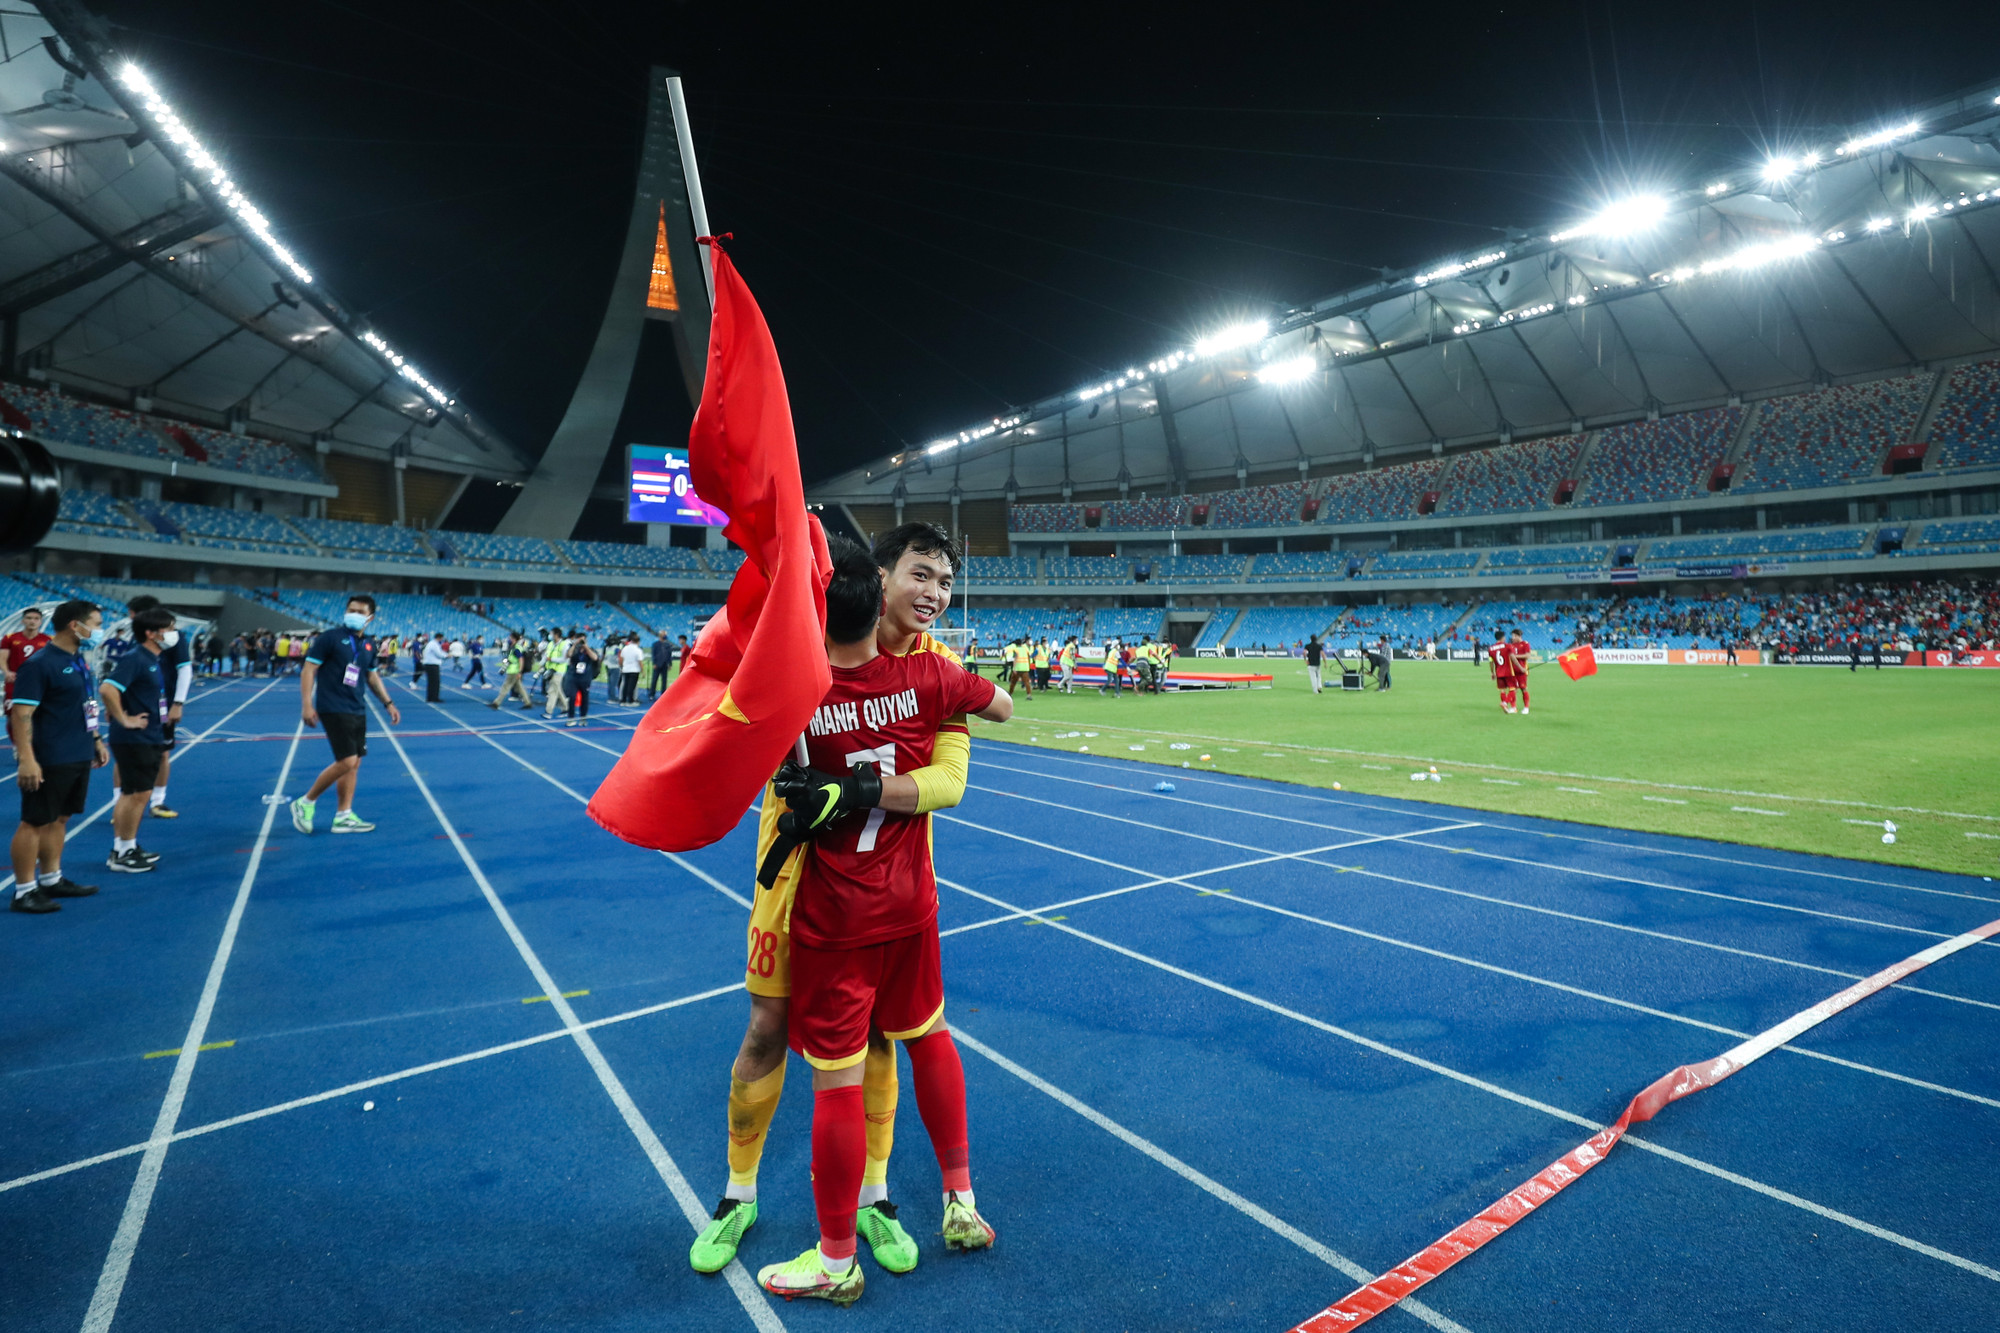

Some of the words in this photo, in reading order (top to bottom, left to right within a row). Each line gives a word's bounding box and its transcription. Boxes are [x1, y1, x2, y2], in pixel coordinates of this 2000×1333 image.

[23, 645, 34, 657] 9
[1495, 650, 1504, 666] 6
[1594, 652, 1650, 662] HAMPIONS
[1699, 652, 1717, 662] FPT
[809, 702, 860, 737] MANH
[863, 688, 919, 732] QUYNH
[845, 743, 896, 853] 7
[747, 926, 778, 979] 28
